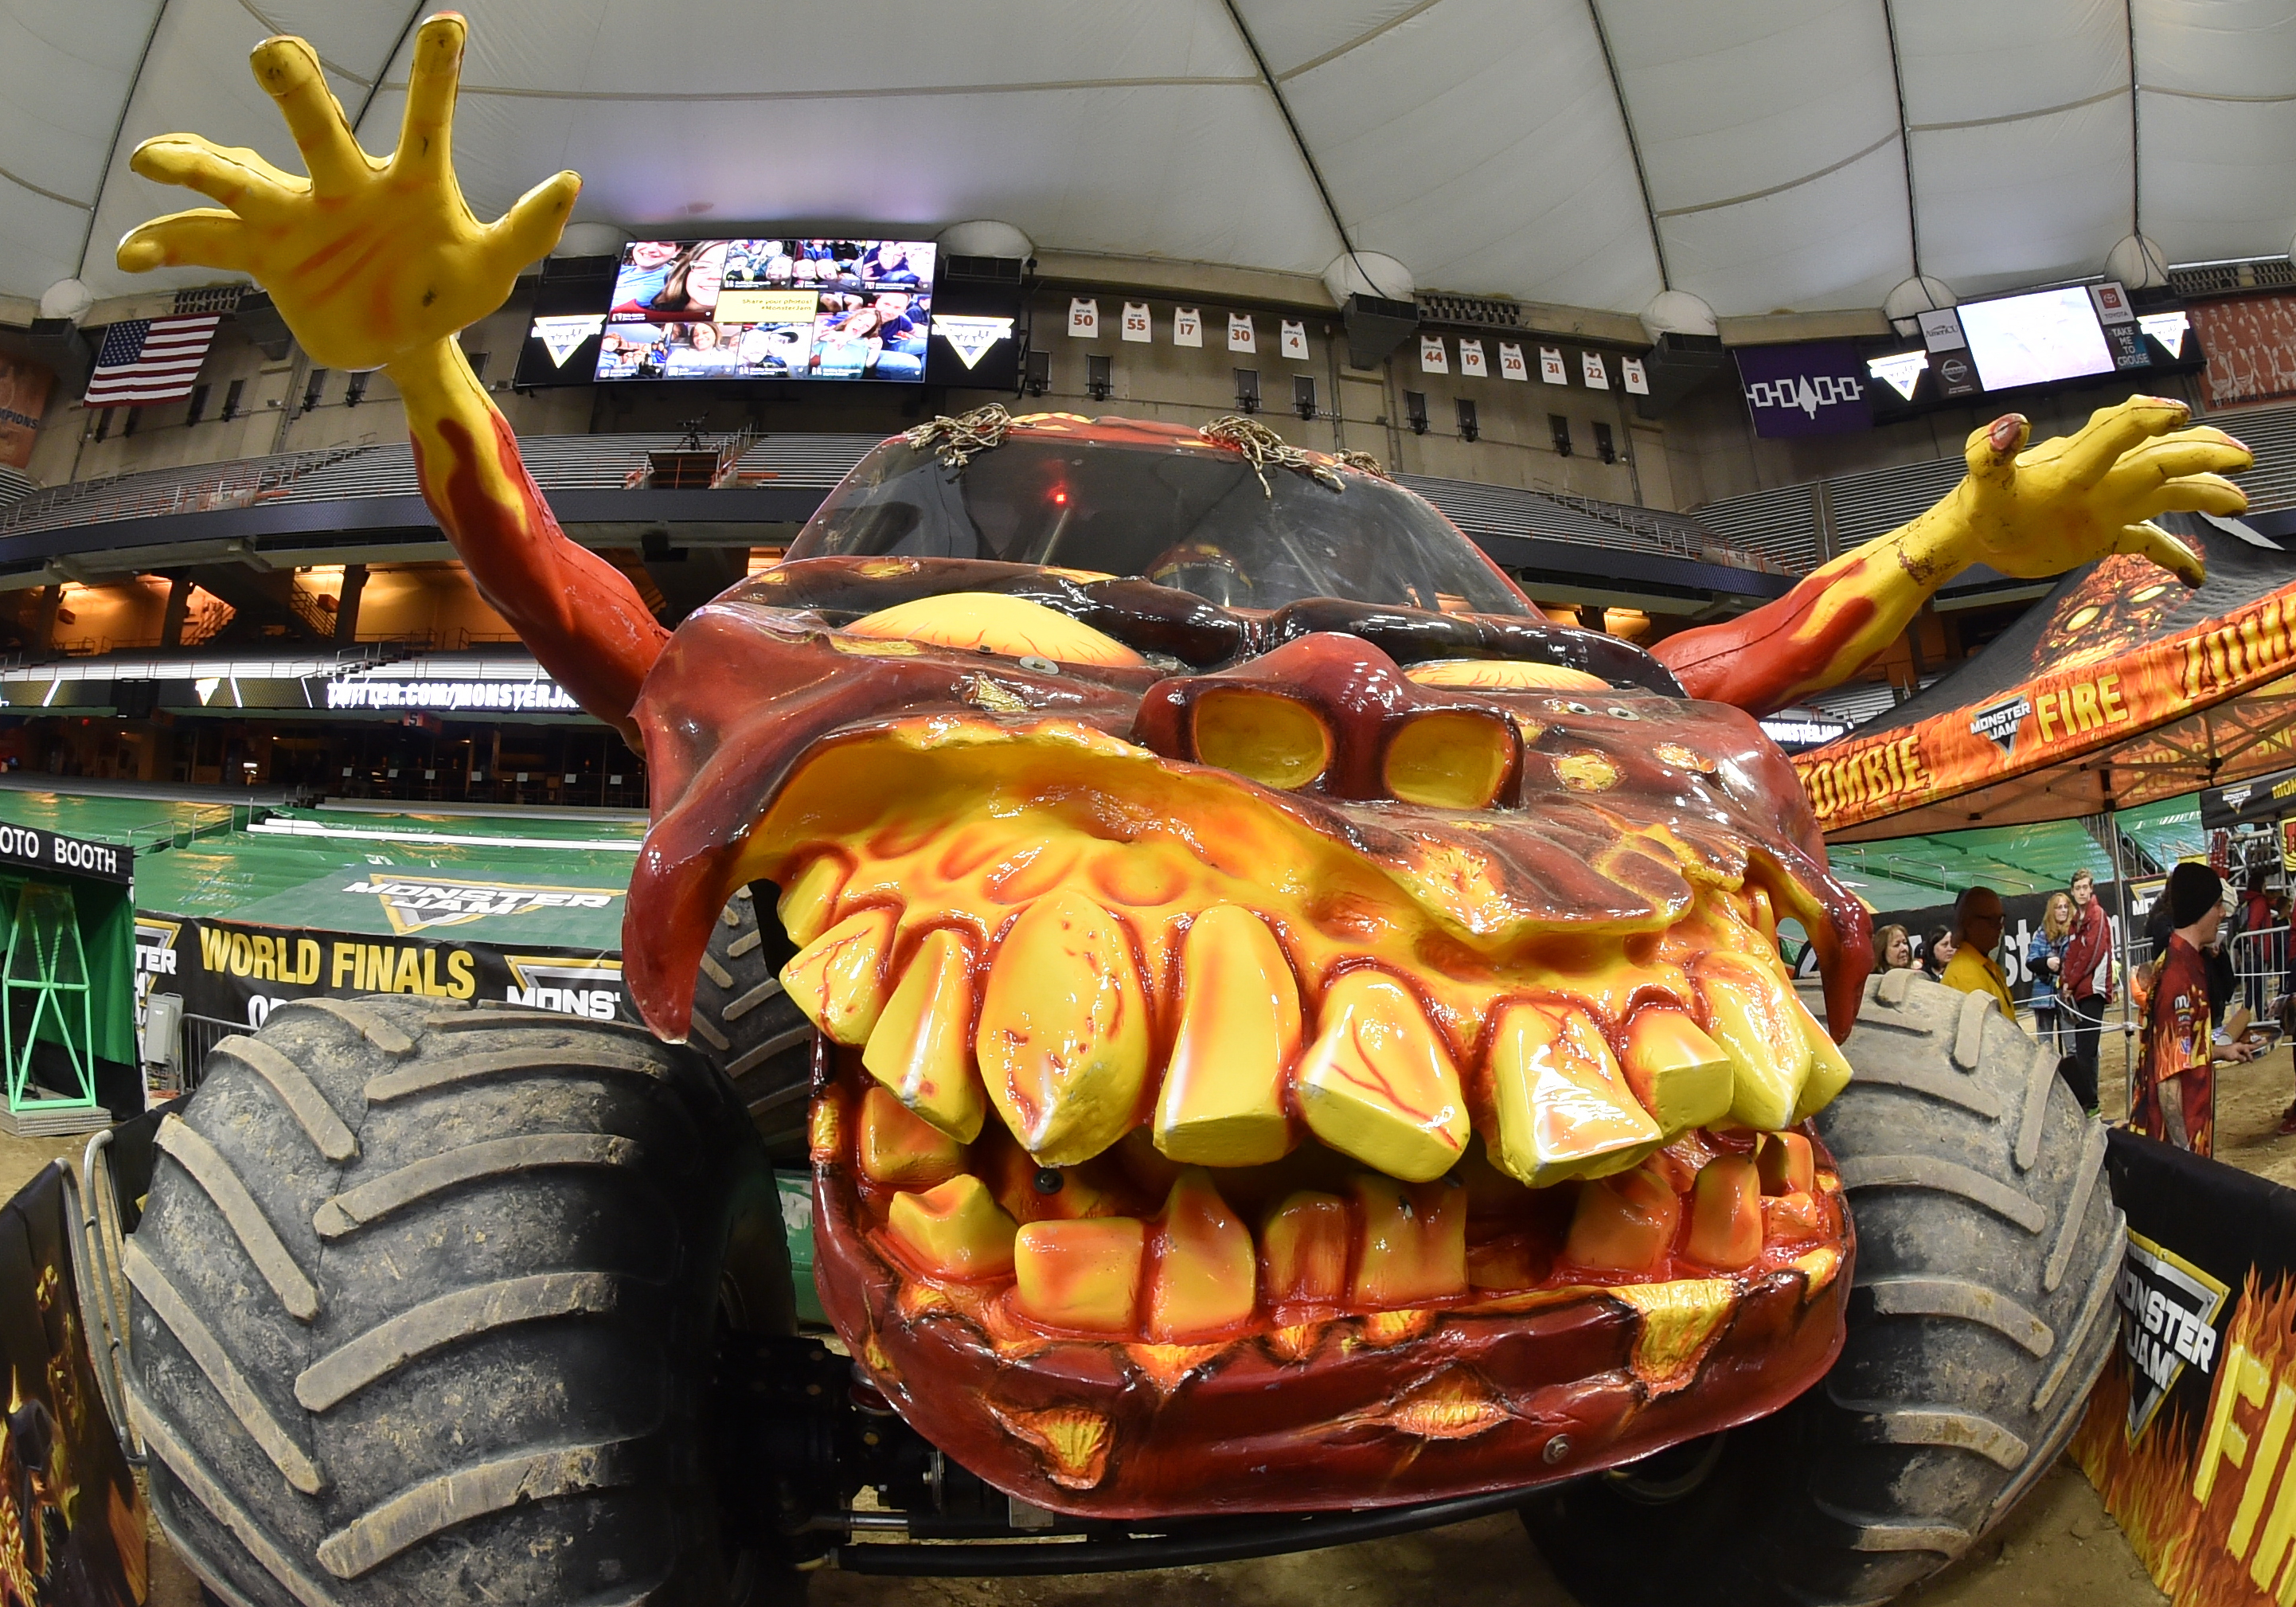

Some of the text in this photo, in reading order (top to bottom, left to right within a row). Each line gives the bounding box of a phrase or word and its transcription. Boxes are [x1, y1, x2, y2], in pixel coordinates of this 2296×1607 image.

[1073, 314, 1094, 326] 50
[1127, 319, 1146, 330] 55
[1180, 323, 1195, 336] 17
[1232, 329, 1251, 342] 30
[2111, 326, 2134, 337] TAKE
[1290, 337, 1299, 349] 4
[2119, 336, 2134, 346] ME
[2122, 345, 2136, 354] TO
[1425, 351, 1443, 363] 44
[1466, 354, 1479, 366] 19
[2118, 353, 2150, 366] CROUSE
[1505, 358, 1521, 370] 20
[1547, 362, 1560, 374] 31
[1587, 367, 1603, 379] 22
[1631, 373, 1639, 383] 8
[2036, 674, 2128, 742] FIRE
[1970, 702, 2031, 734] MONSTER
[1989, 720, 2017, 741] JAM
[55, 838, 116, 874] BOOTH
[342, 882, 612, 909] MONSTER
[389, 897, 520, 915] JAM
[200, 926, 321, 985] WORLD
[331, 942, 475, 999] FINALS
[2126, 1324, 2173, 1390] JAM
